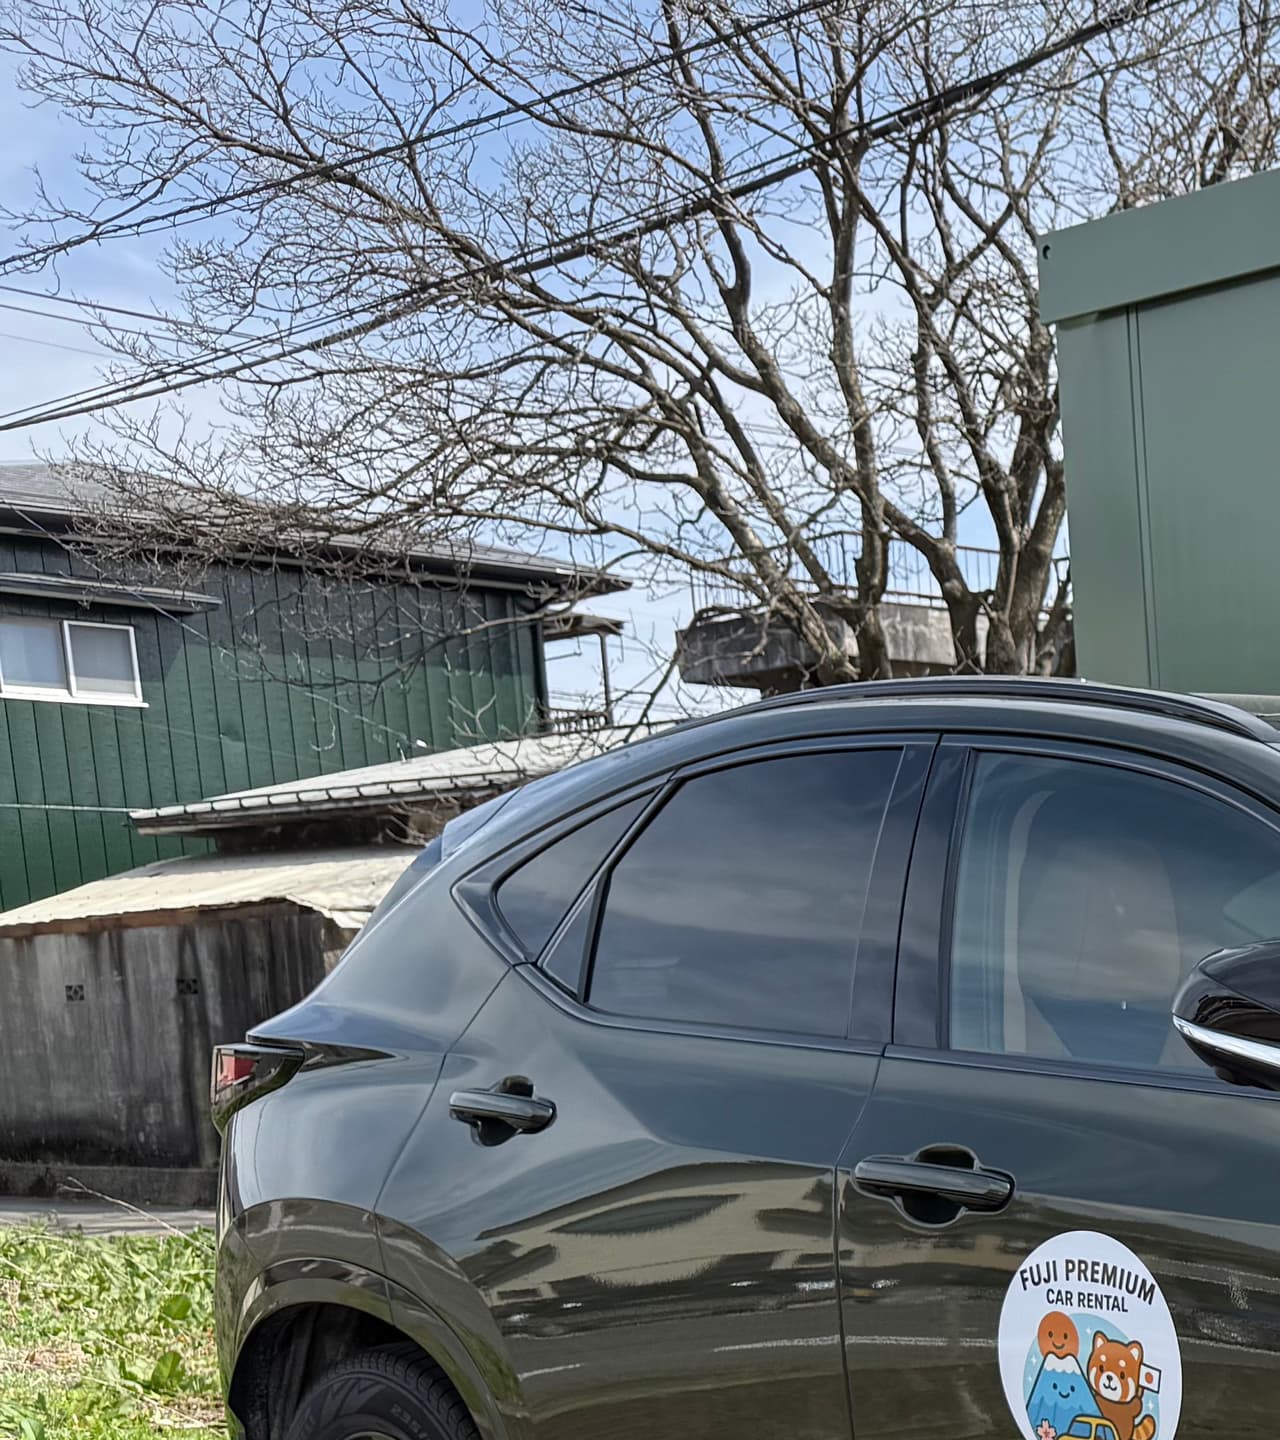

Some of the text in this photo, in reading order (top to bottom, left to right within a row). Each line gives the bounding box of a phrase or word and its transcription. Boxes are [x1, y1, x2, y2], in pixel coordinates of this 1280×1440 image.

[1019, 1258, 1156, 1305] FUJI PREMIUM
[1046, 1288, 1129, 1313] CAR RENTAL
